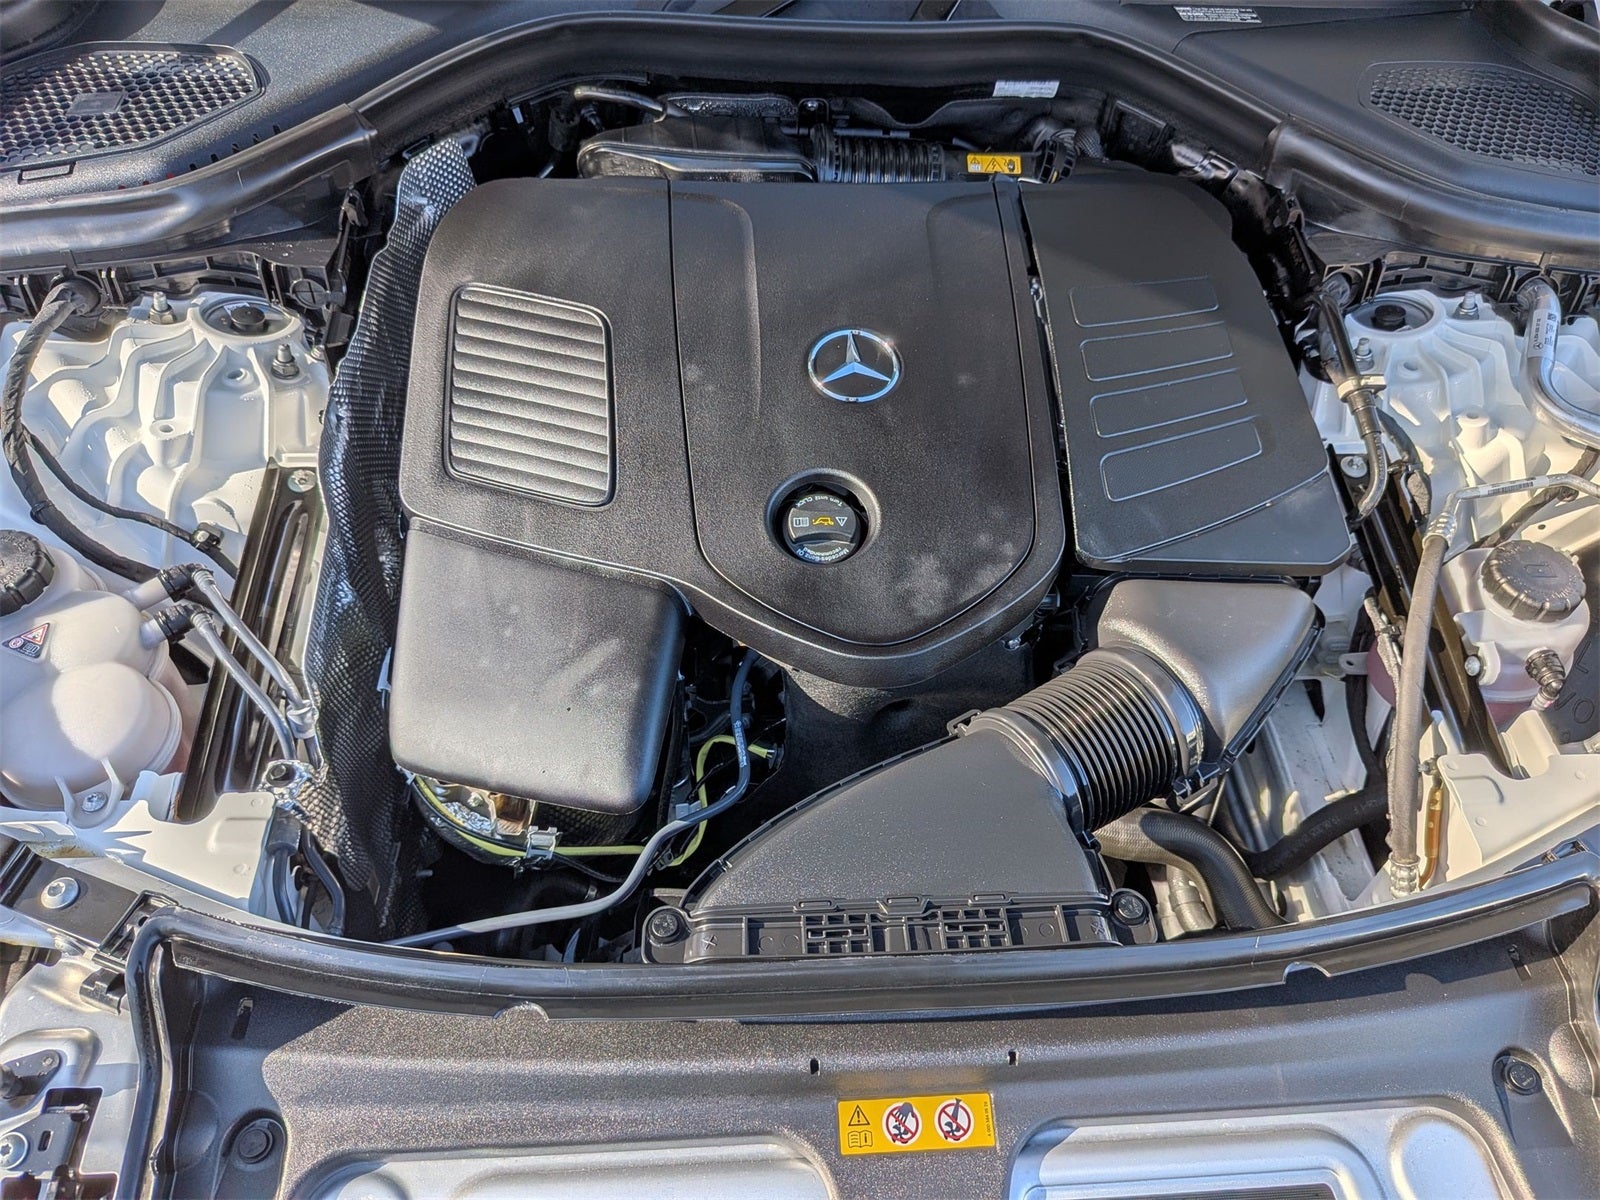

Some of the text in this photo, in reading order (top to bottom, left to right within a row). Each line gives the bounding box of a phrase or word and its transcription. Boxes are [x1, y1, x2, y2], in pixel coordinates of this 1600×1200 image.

[796, 497, 813, 507] CLICK
[830, 498, 843, 507] Turn
[805, 548, 850, 561] Mercedes-Benz
